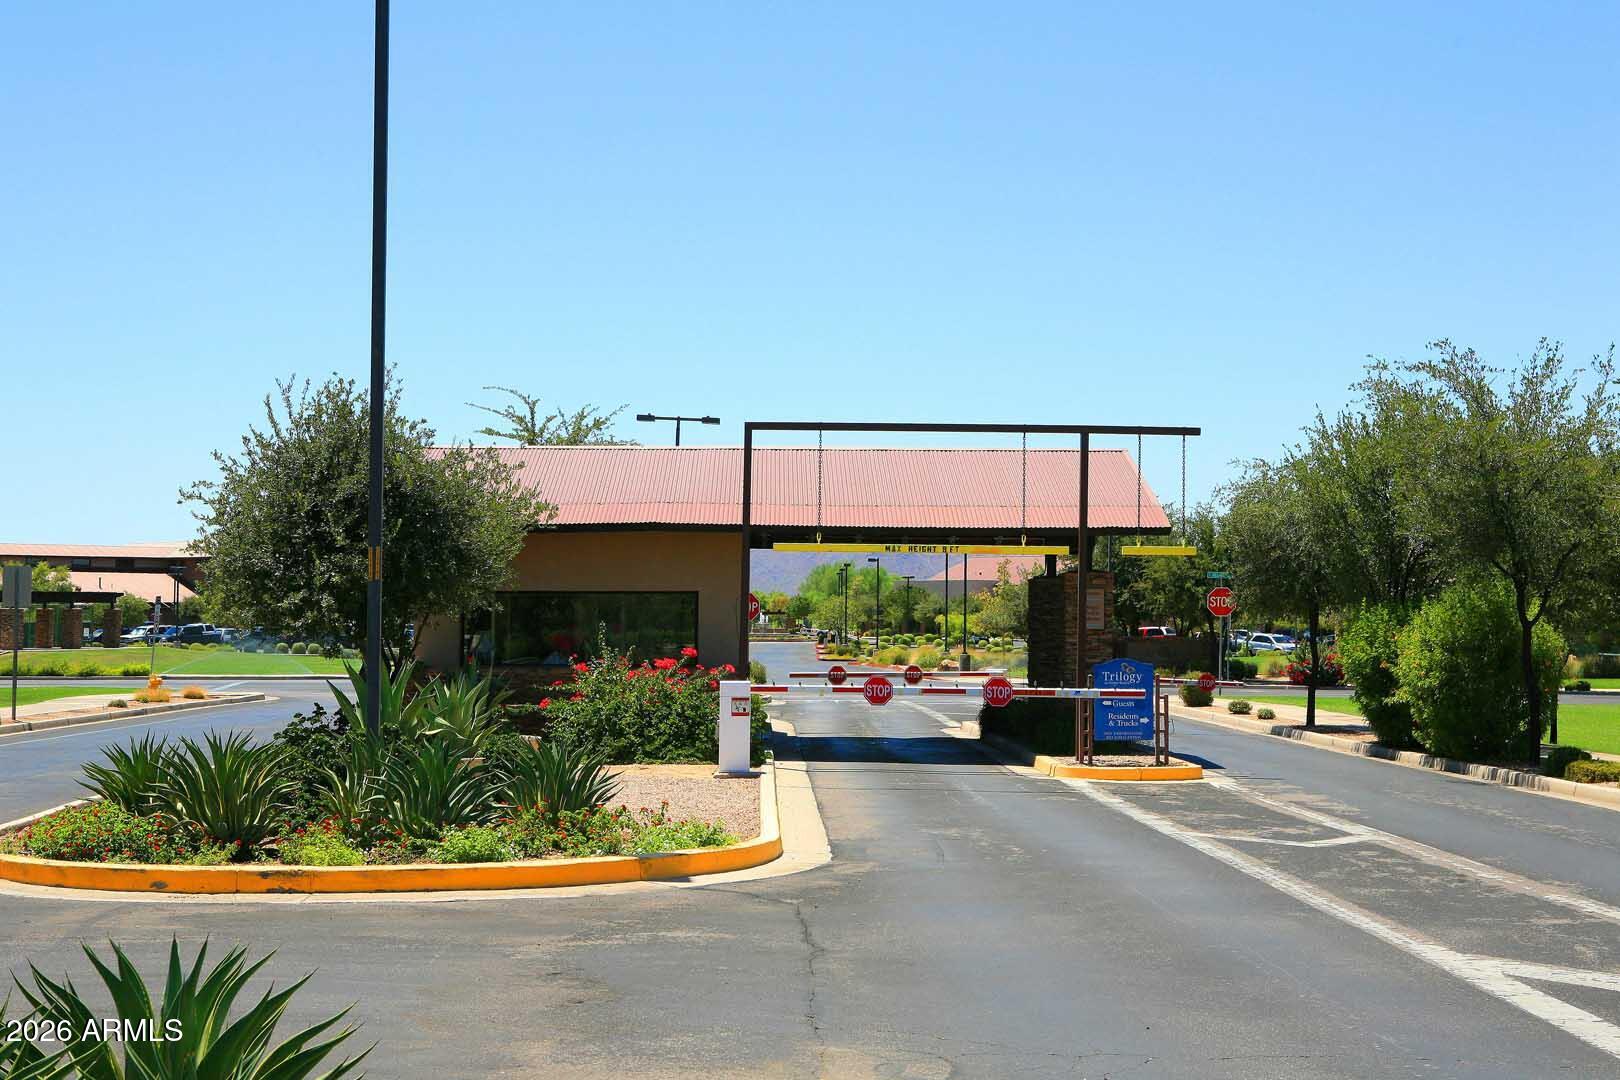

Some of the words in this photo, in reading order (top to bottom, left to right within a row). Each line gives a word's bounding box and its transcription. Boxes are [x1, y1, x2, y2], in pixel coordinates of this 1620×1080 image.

[1210, 596, 1234, 607] STO
[1102, 671, 1142, 684] Trilogy
[866, 685, 891, 697] STOP
[986, 686, 1011, 698] STOP
[1108, 712, 1139, 720] Residents
[1117, 719, 1139, 727] Trucks
